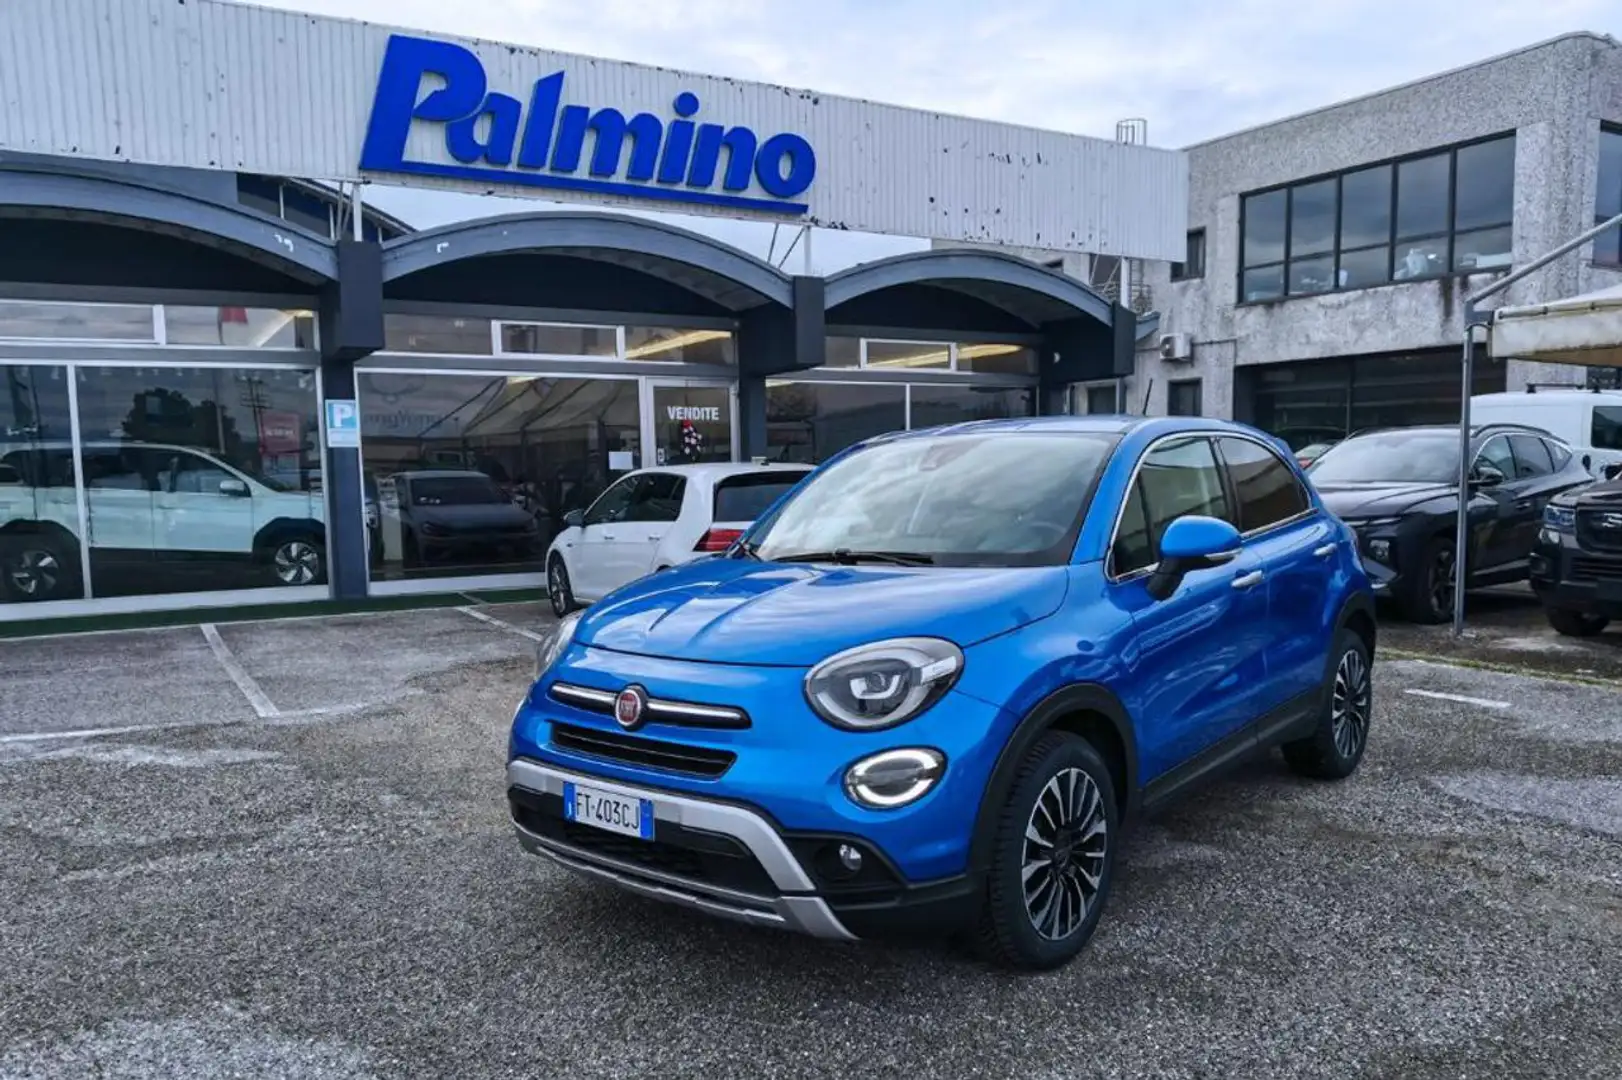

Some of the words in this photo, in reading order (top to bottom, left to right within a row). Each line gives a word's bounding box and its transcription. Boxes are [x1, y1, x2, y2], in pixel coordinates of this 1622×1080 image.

[359, 34, 816, 199] Palmino
[333, 403, 353, 427] P
[667, 406, 719, 420] VENDITE
